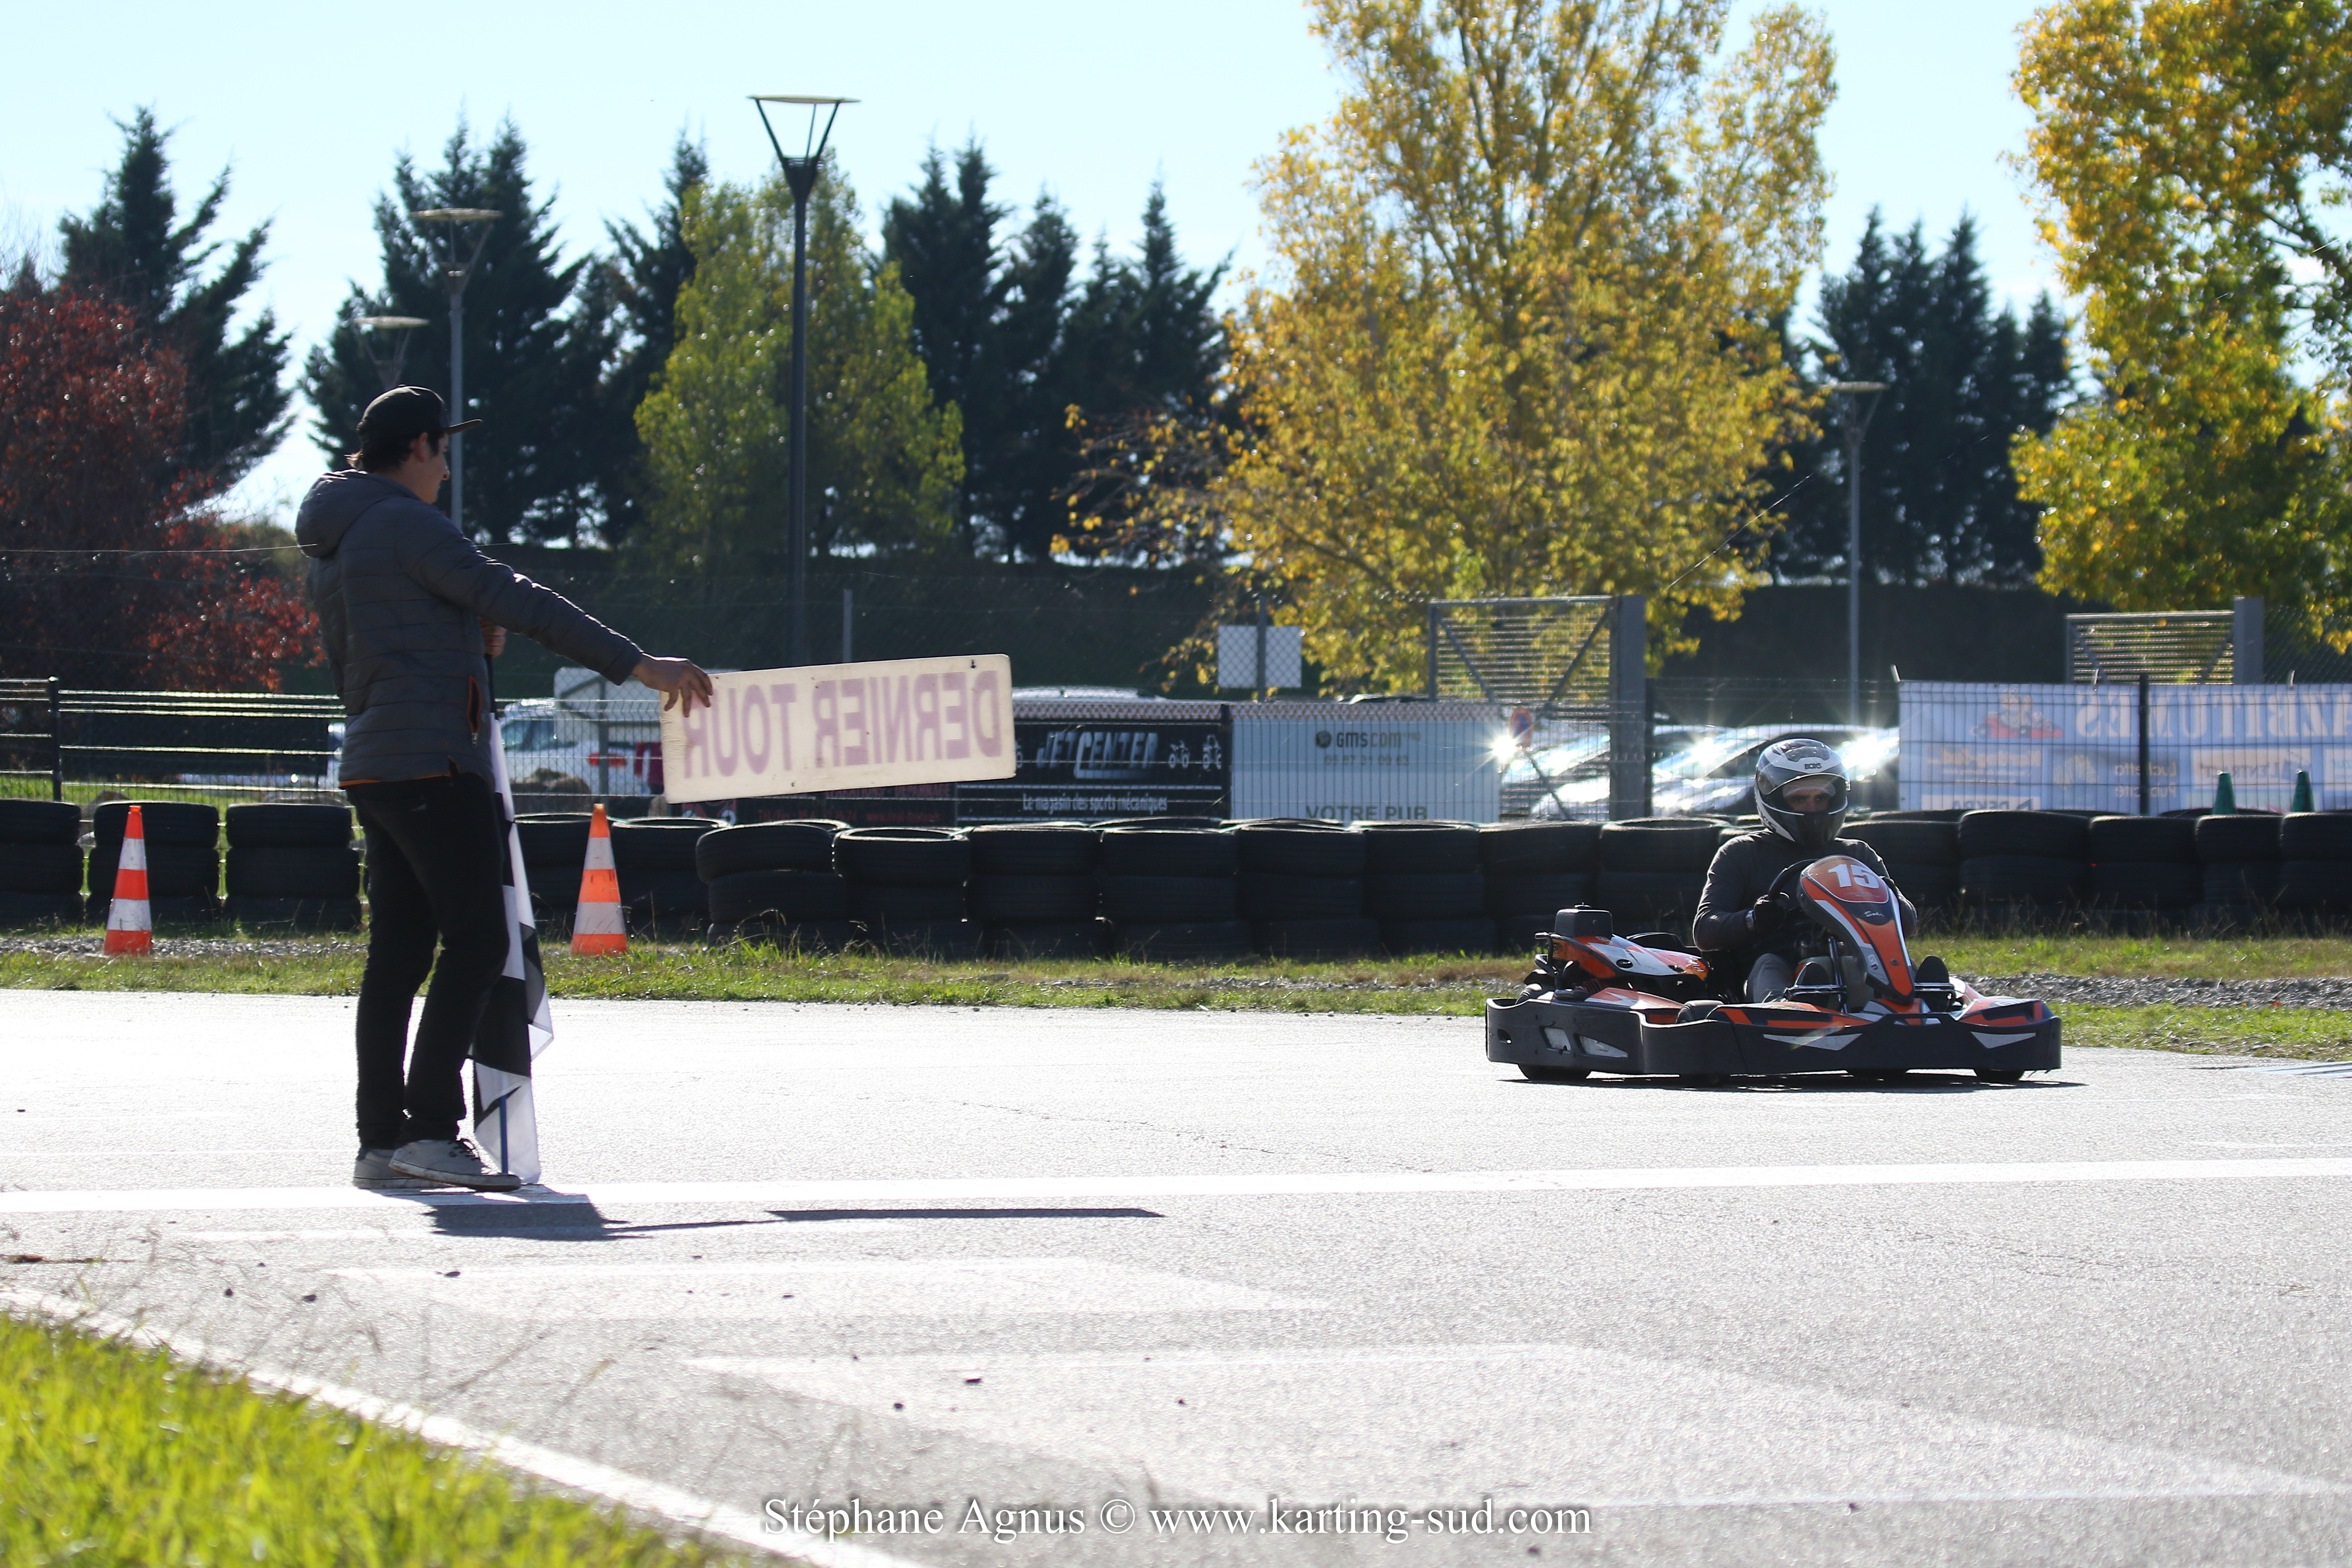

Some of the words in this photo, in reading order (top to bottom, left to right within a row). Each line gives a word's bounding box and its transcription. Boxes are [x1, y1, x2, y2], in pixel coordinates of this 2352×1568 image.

[1023, 793, 1032, 811] Le
[1035, 792, 1071, 815] magasin
[1072, 792, 1088, 811] des
[1306, 806, 1378, 819] VOTRE
[1385, 806, 1427, 820] PUB
[1828, 864, 1880, 889] 15
